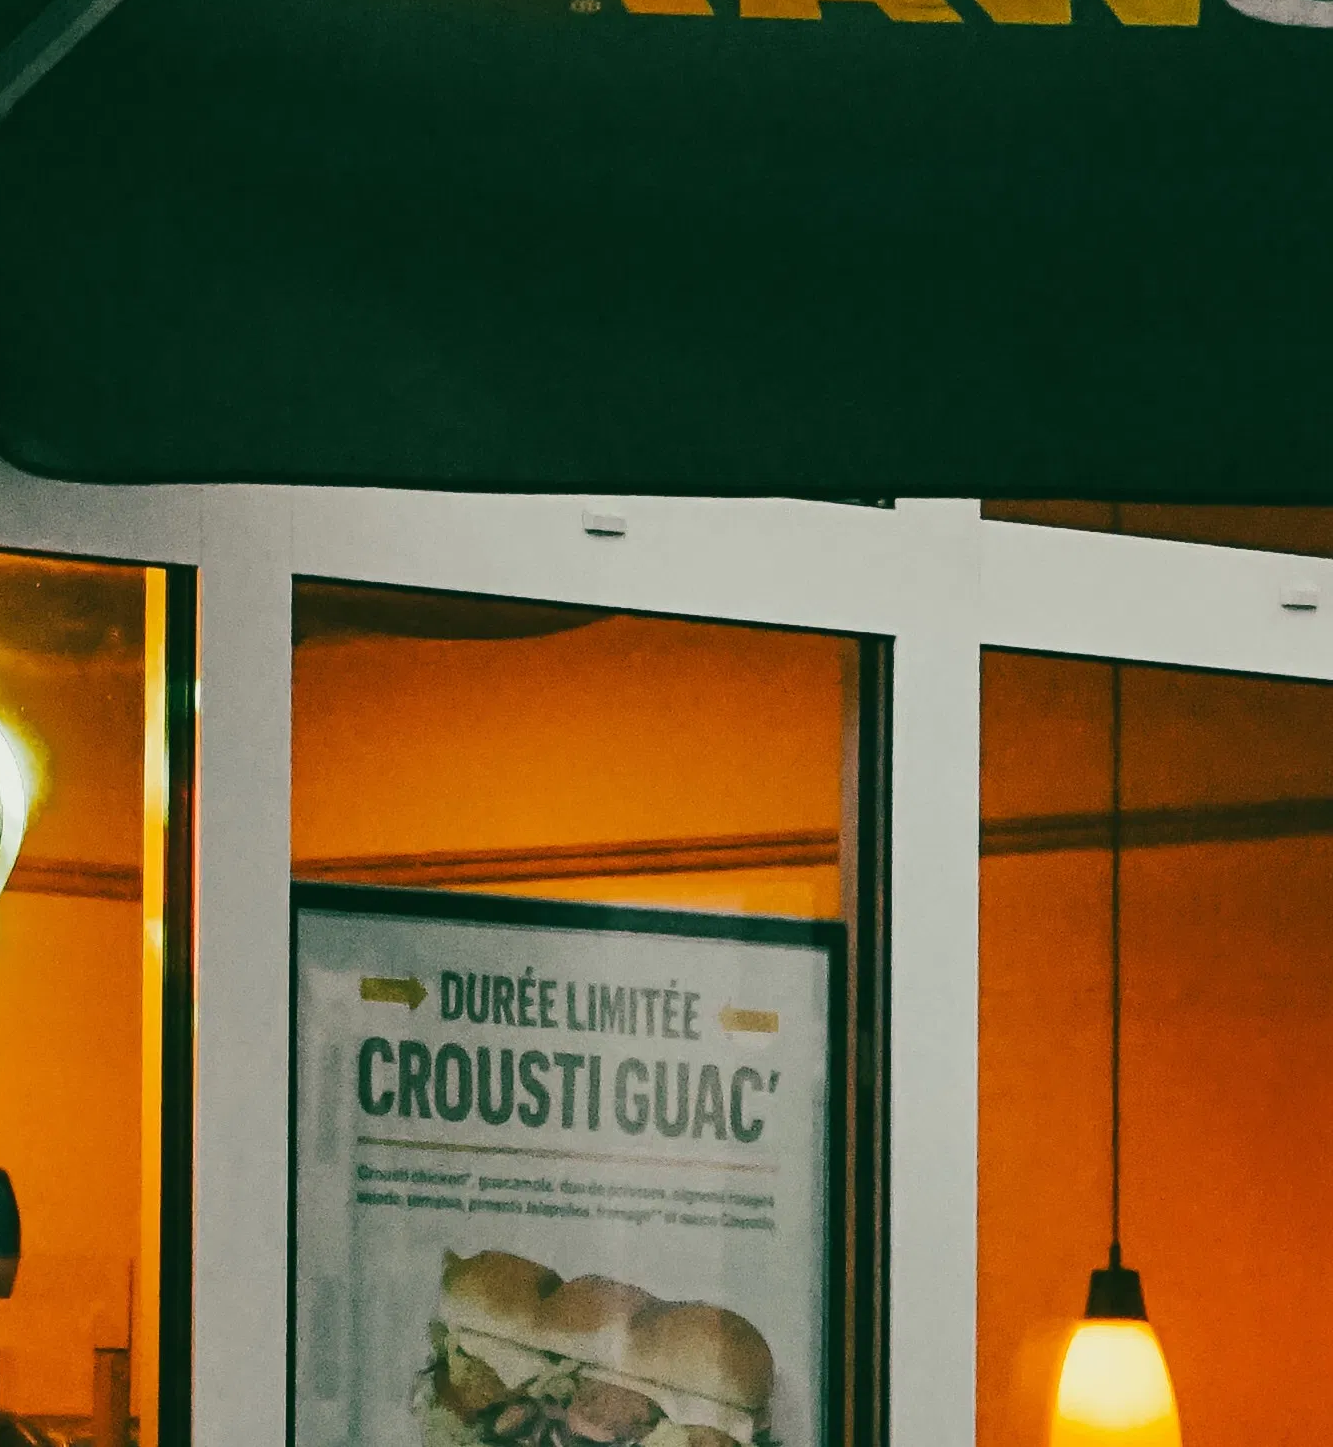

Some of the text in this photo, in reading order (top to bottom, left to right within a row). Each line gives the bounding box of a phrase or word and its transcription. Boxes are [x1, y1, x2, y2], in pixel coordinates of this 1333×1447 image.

[440, 966, 702, 1041] DURÉE LIMITÉE
[357, 1036, 781, 1143] CROUSTI GUAC'
